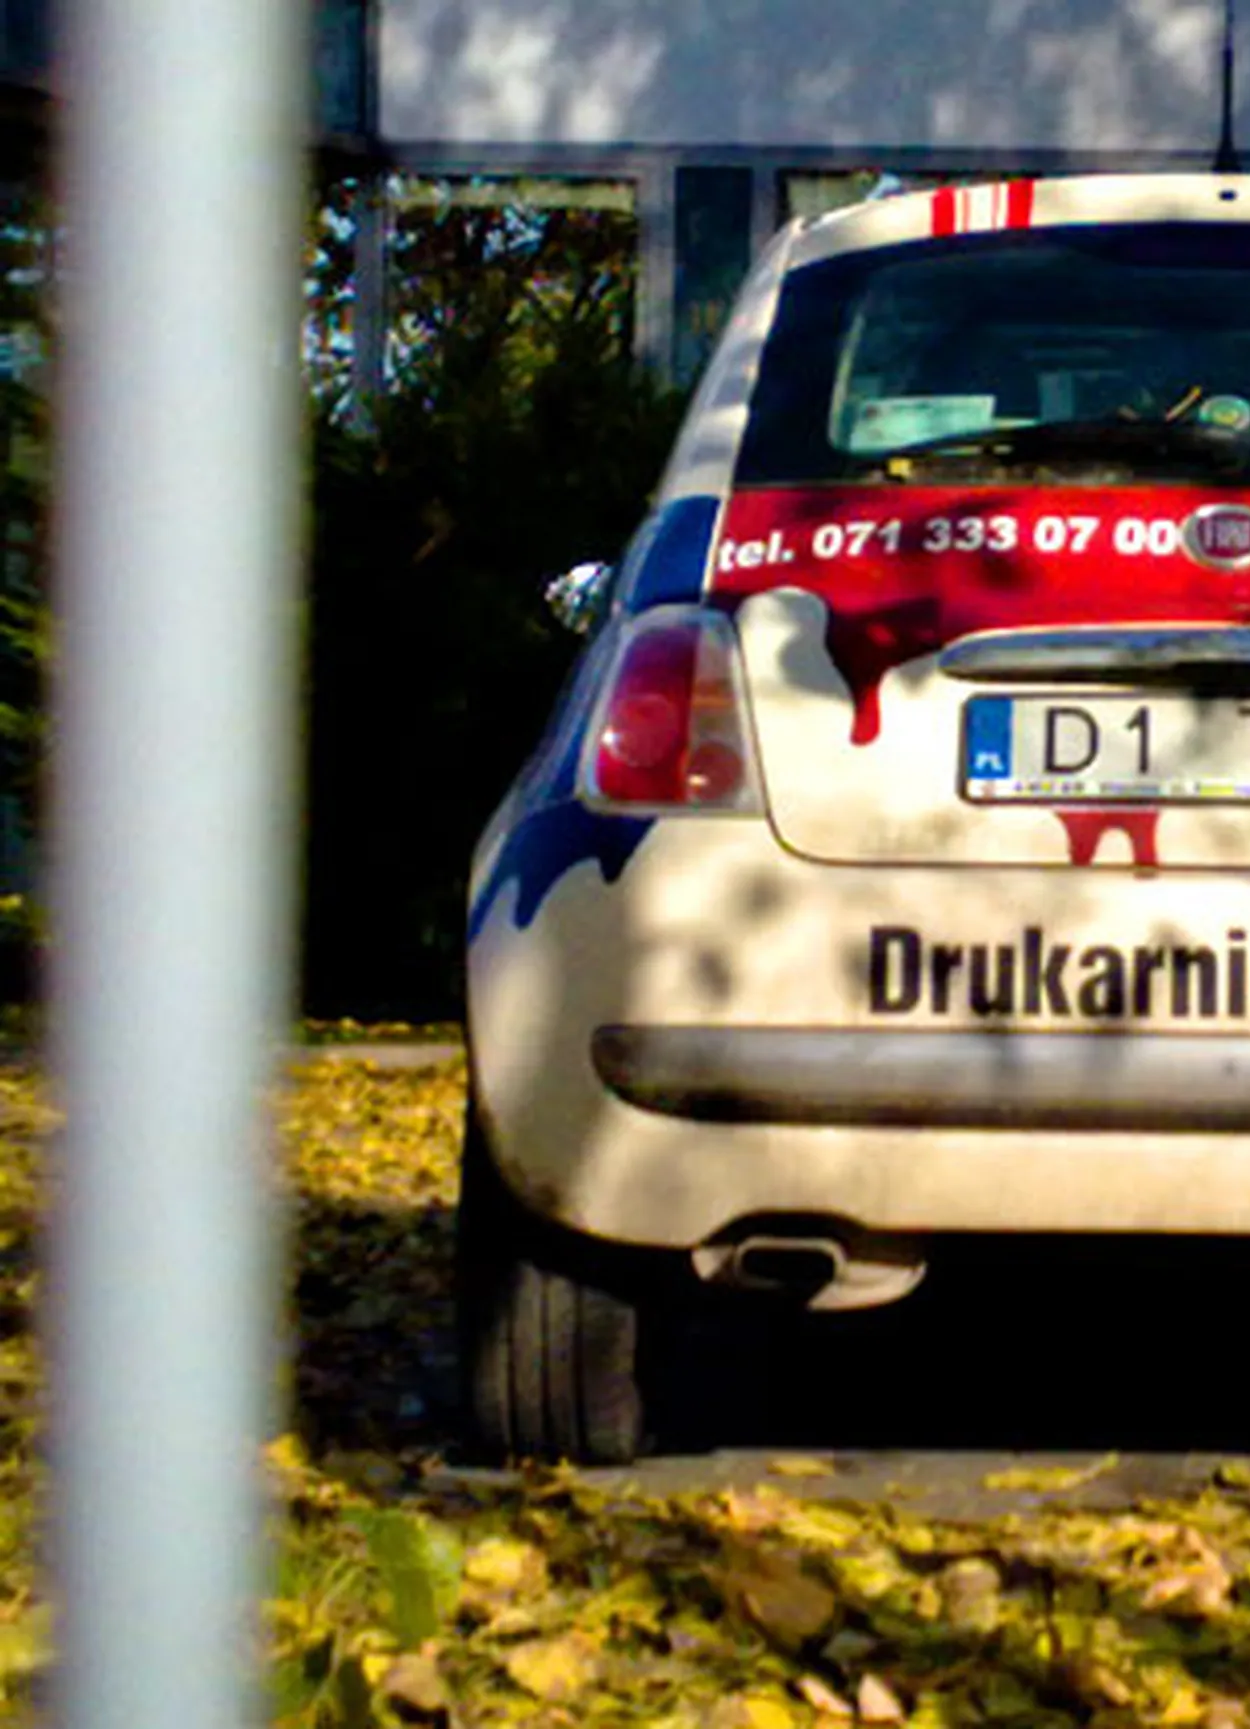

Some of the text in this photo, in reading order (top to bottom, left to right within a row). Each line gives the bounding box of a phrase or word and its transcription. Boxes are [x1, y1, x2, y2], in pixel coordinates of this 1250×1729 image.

[717, 508, 1178, 572] tel. 071 333 07 00
[1045, 706, 1148, 775] D1
